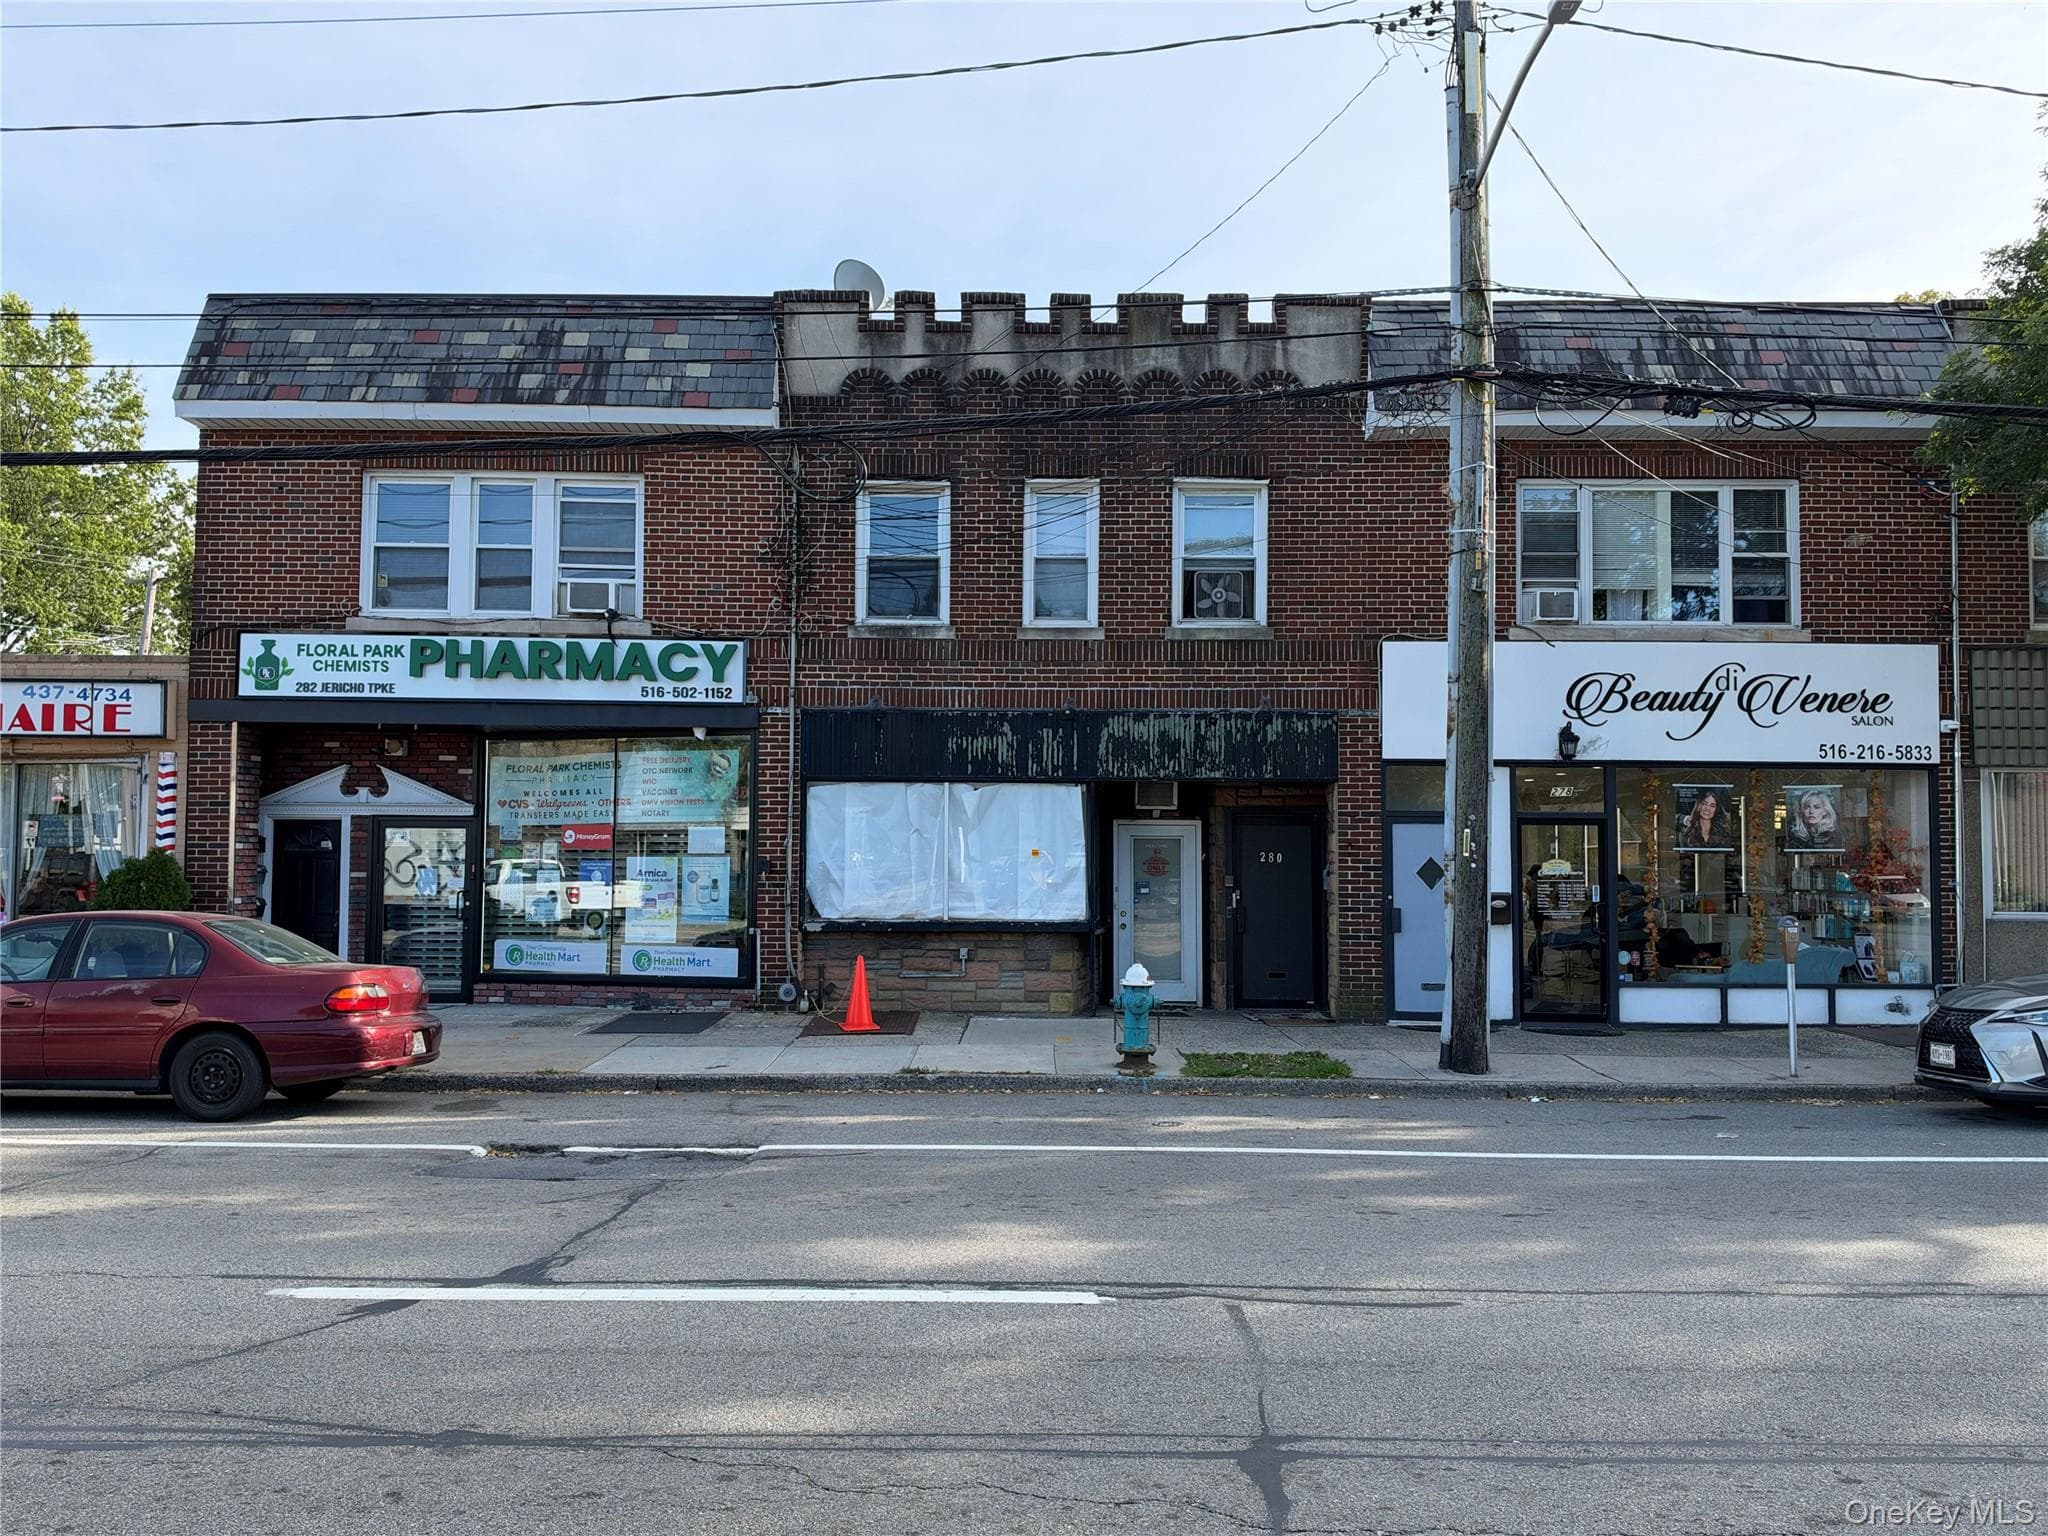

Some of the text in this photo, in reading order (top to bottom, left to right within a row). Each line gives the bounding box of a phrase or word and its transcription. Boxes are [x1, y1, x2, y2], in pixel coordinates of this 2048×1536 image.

[297, 643, 406, 658] FLORAL PARK
[313, 660, 390, 672] CHEMISTS
[409, 638, 738, 682] PHARMACY
[22, 685, 132, 702] 437-4734
[295, 682, 396, 694] 282 JERICHO TPKE
[640, 686, 734, 699] 516-502-1152
[1562, 662, 1893, 741] Beauty di Venere
[0, 703, 132, 732] AIRE
[1850, 715, 1894, 727] SALON
[1818, 744, 1933, 761] 516-216-5833
[659, 756, 692, 764] DELIVERY
[506, 760, 622, 774] FLORAL PARK CHEMISTS
[642, 767, 657, 775] OTC
[531, 774, 597, 785] PHARMACY
[523, 787, 604, 797] WELCOMES ALL
[641, 788, 678, 796] VACCINES
[1550, 787, 1573, 797] 278
[508, 799, 530, 809] CVS
[536, 799, 589, 810] Walgreens
[509, 811, 560, 820] TRANSFERS
[563, 810, 589, 818] MADE
[1259, 851, 1283, 863] 280
[636, 868, 668, 878] Arnica
[525, 951, 556, 961] Health
[558, 952, 581, 962] Mart
[653, 956, 686, 966] Health
[687, 957, 712, 967] Mart
